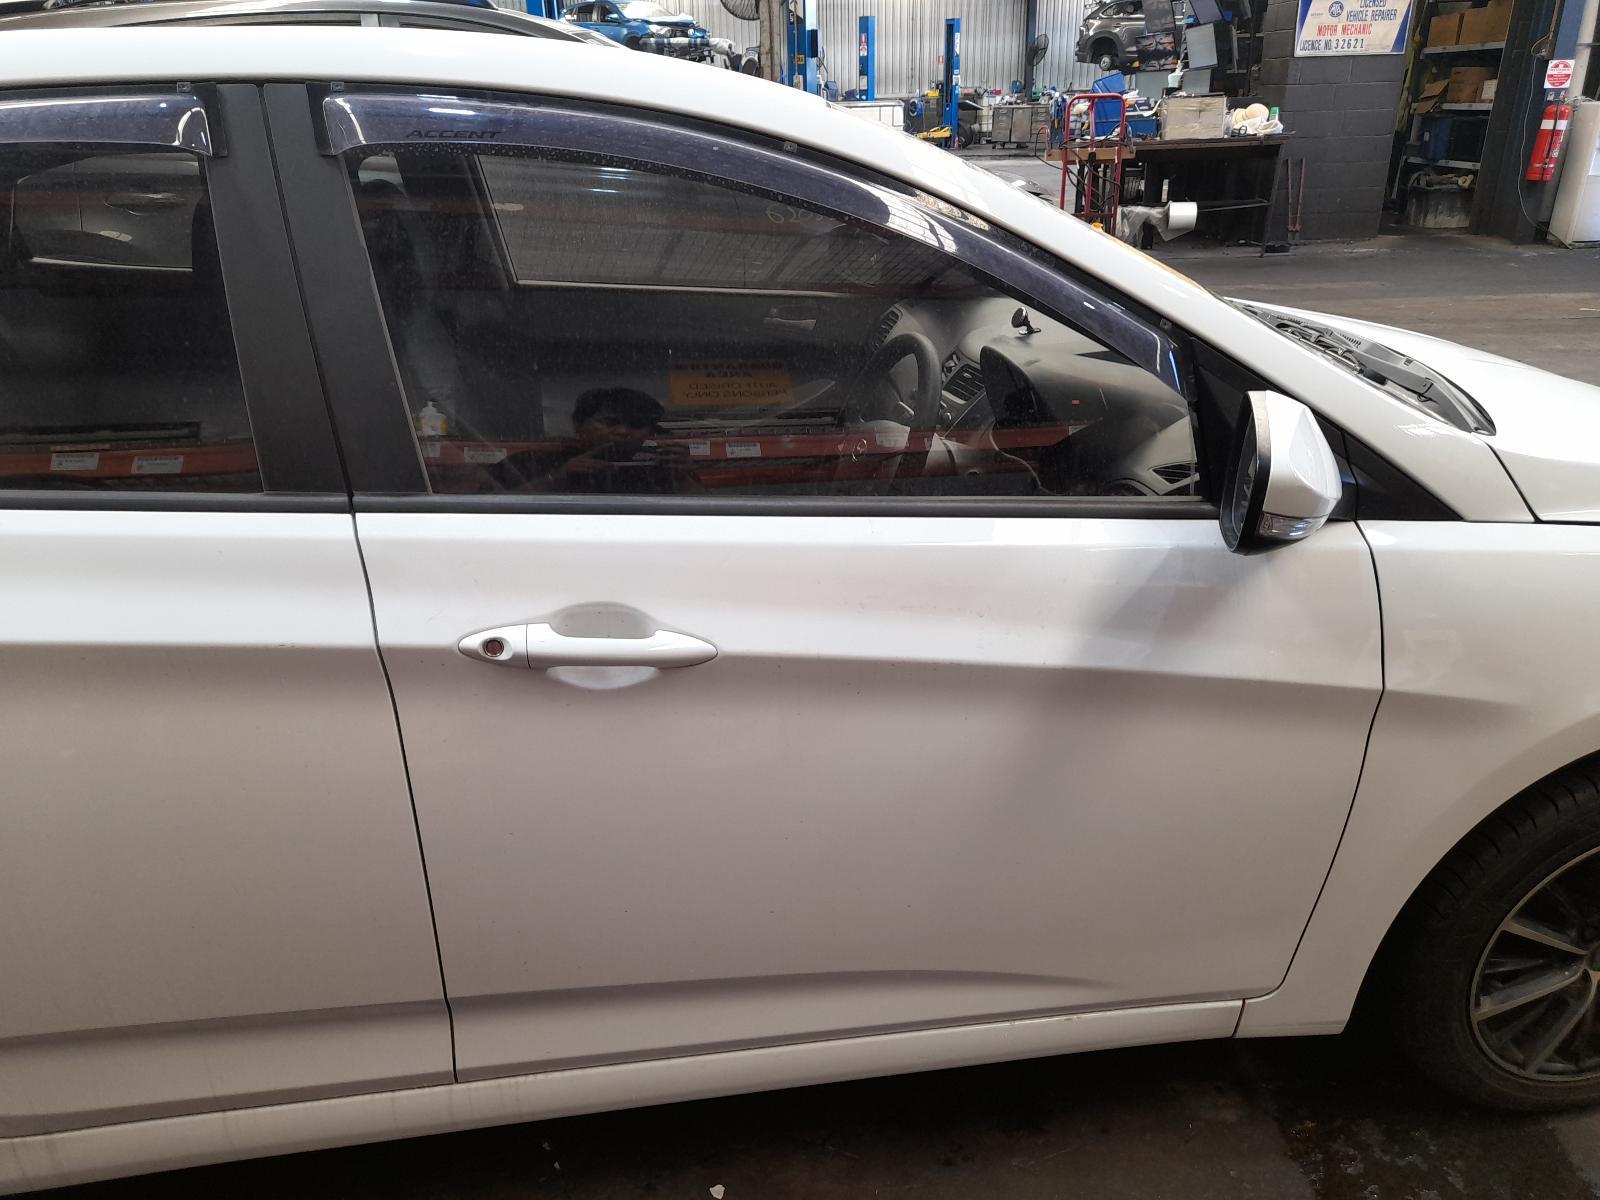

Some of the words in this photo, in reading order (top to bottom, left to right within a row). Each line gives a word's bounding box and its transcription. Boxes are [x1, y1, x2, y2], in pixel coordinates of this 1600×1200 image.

[1359, 0, 1387, 8] LICENSED
[1346, 10, 1368, 22] VEHICLE
[1370, 8, 1398, 21] REPAIRER
[1317, 25, 1337, 36] MOTOR
[1341, 23, 1373, 35] MECHANIC
[1299, 39, 1321, 52] LICENCE
[1334, 39, 1364, 50] 32621
[407, 130, 503, 139] ACCENT
